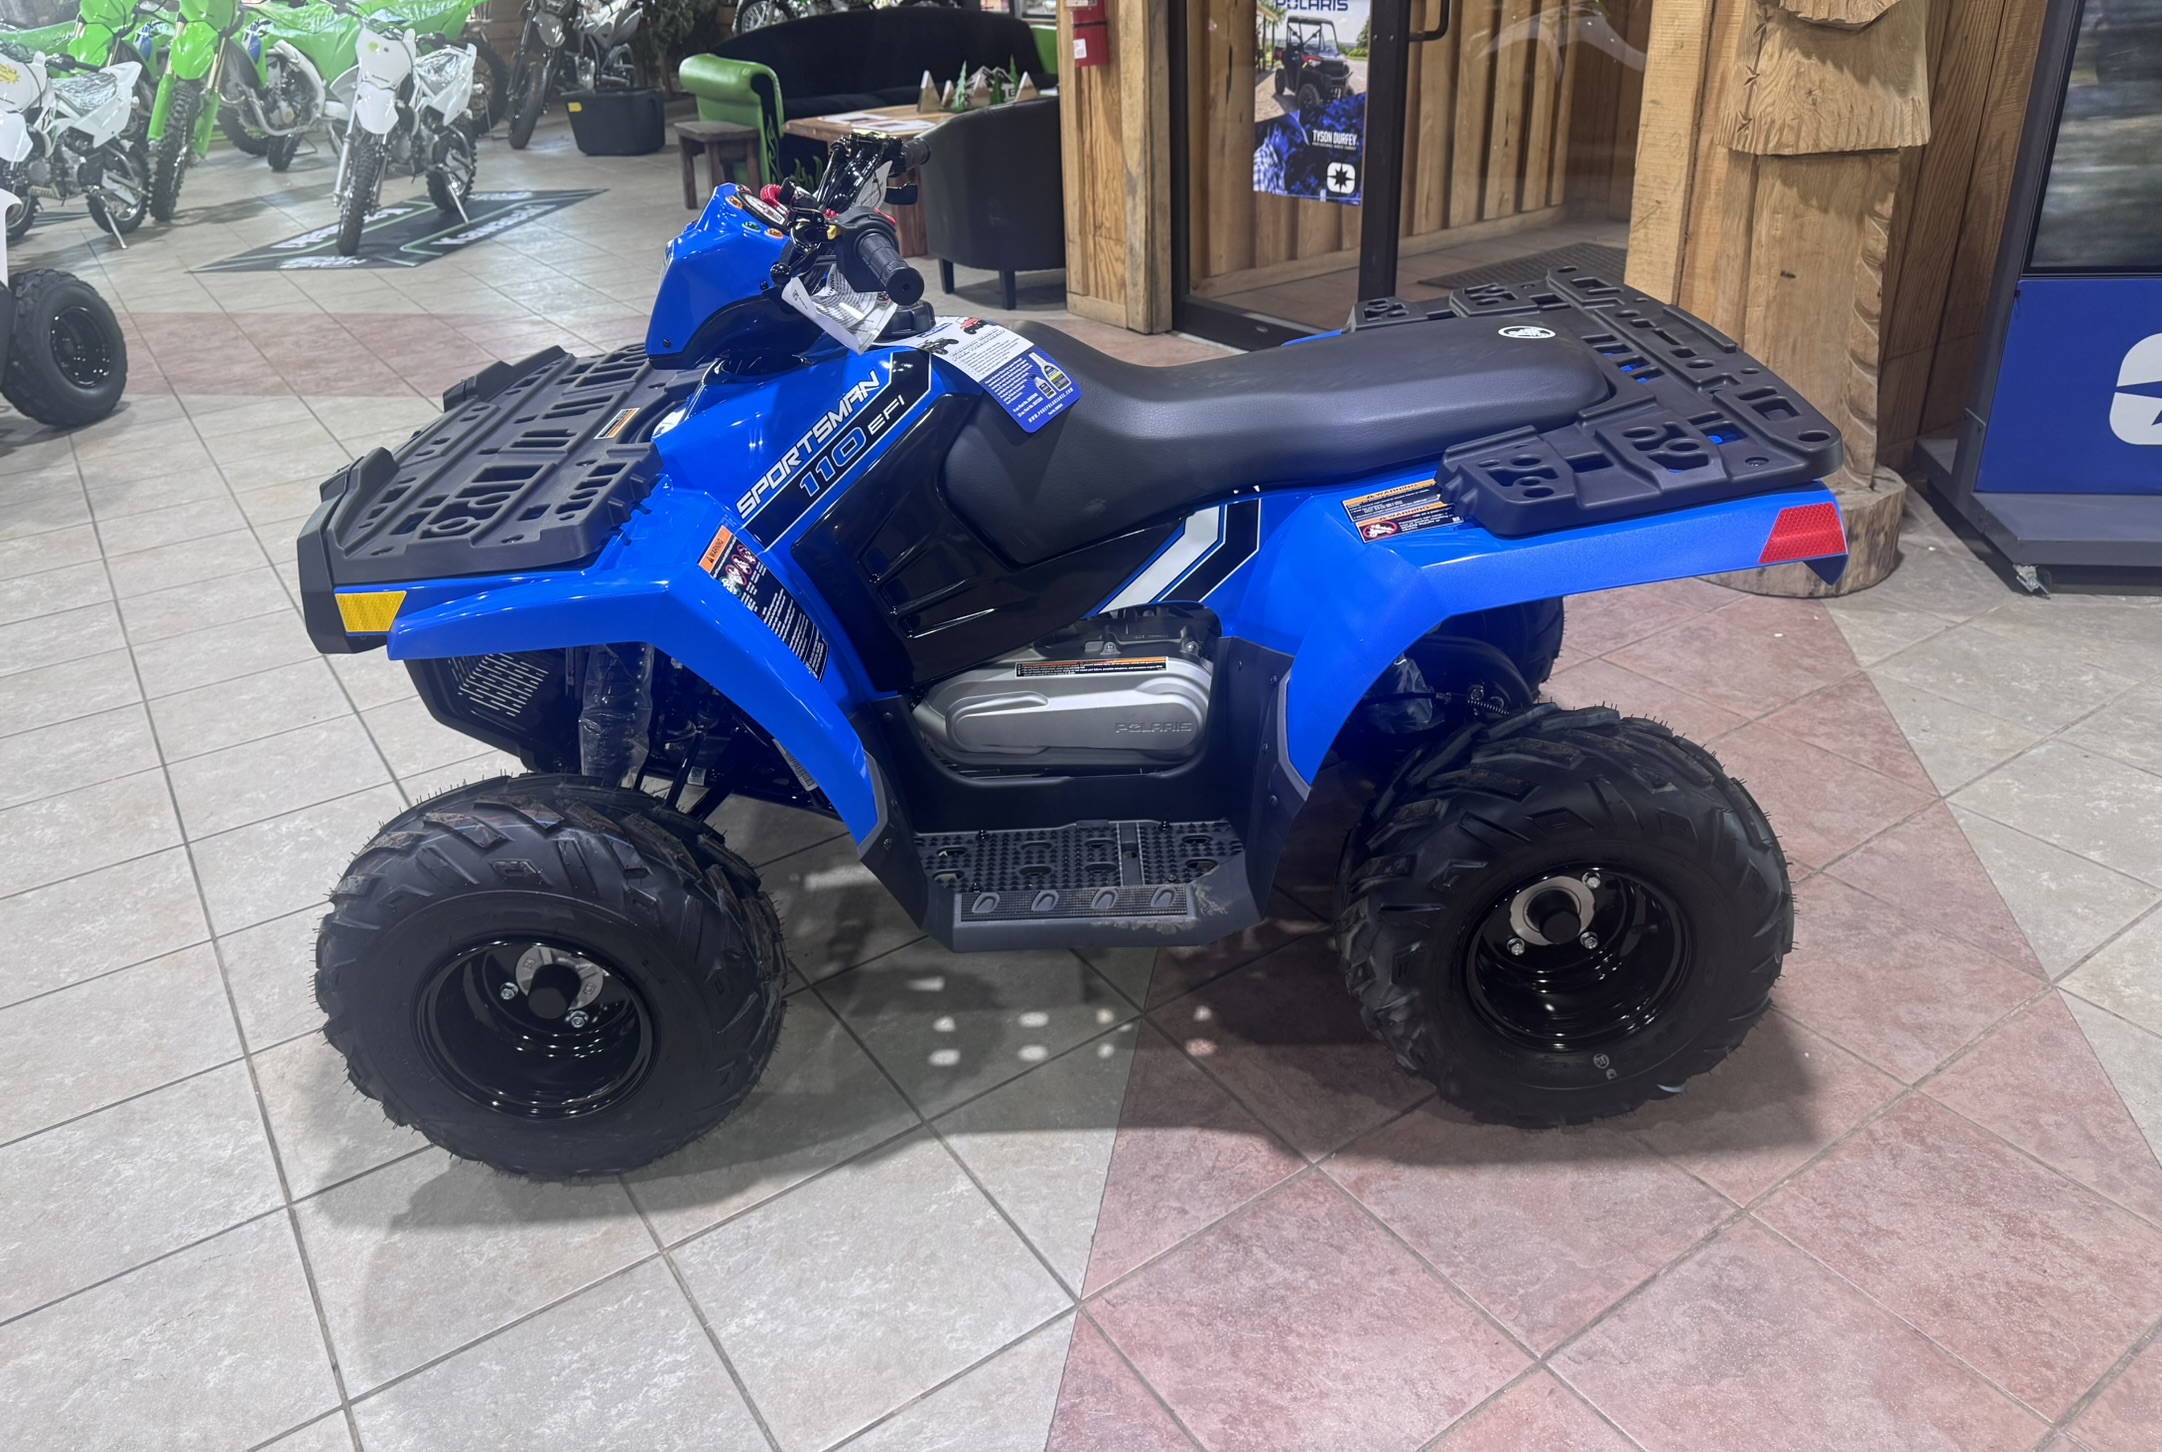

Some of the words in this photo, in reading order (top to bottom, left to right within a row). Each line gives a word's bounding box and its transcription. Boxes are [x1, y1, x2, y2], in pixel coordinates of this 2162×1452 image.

[1275, 0, 1348, 11] POLARIS
[1312, 130, 1332, 143] TYSON
[1332, 132, 1357, 146] DURFEY
[735, 370, 881, 519] SPORTSMAN
[800, 427, 866, 497] 110
[868, 395, 905, 435] EFI
[1115, 722, 1192, 733] POLARIS
